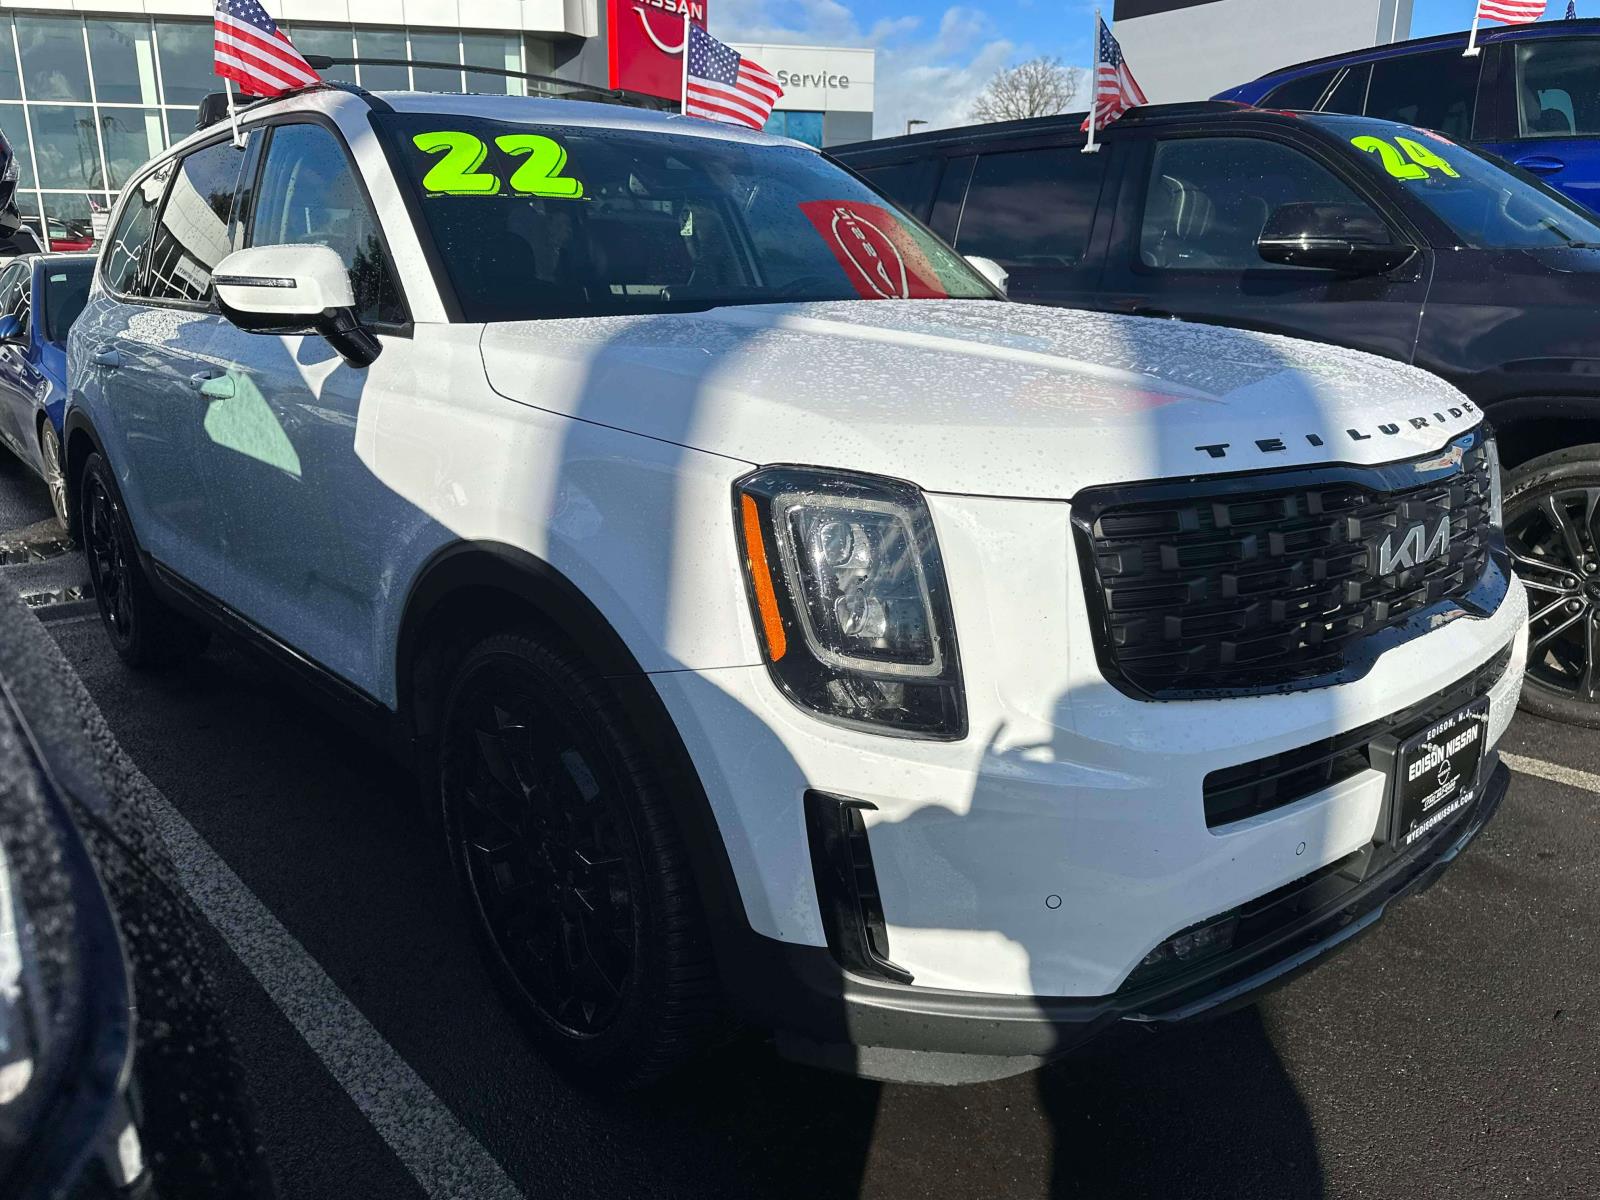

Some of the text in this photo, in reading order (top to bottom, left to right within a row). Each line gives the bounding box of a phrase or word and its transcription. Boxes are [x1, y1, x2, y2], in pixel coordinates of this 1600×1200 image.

[639, 0, 703, 20] SSAN
[776, 69, 850, 89] Service
[412, 131, 584, 199] 22
[1350, 135, 1460, 181] 24
[1380, 514, 1451, 577] KIA
[1408, 723, 1479, 782] EDISON NISSAN
[1406, 790, 1474, 846] MYEDISONNISSAN.COM
